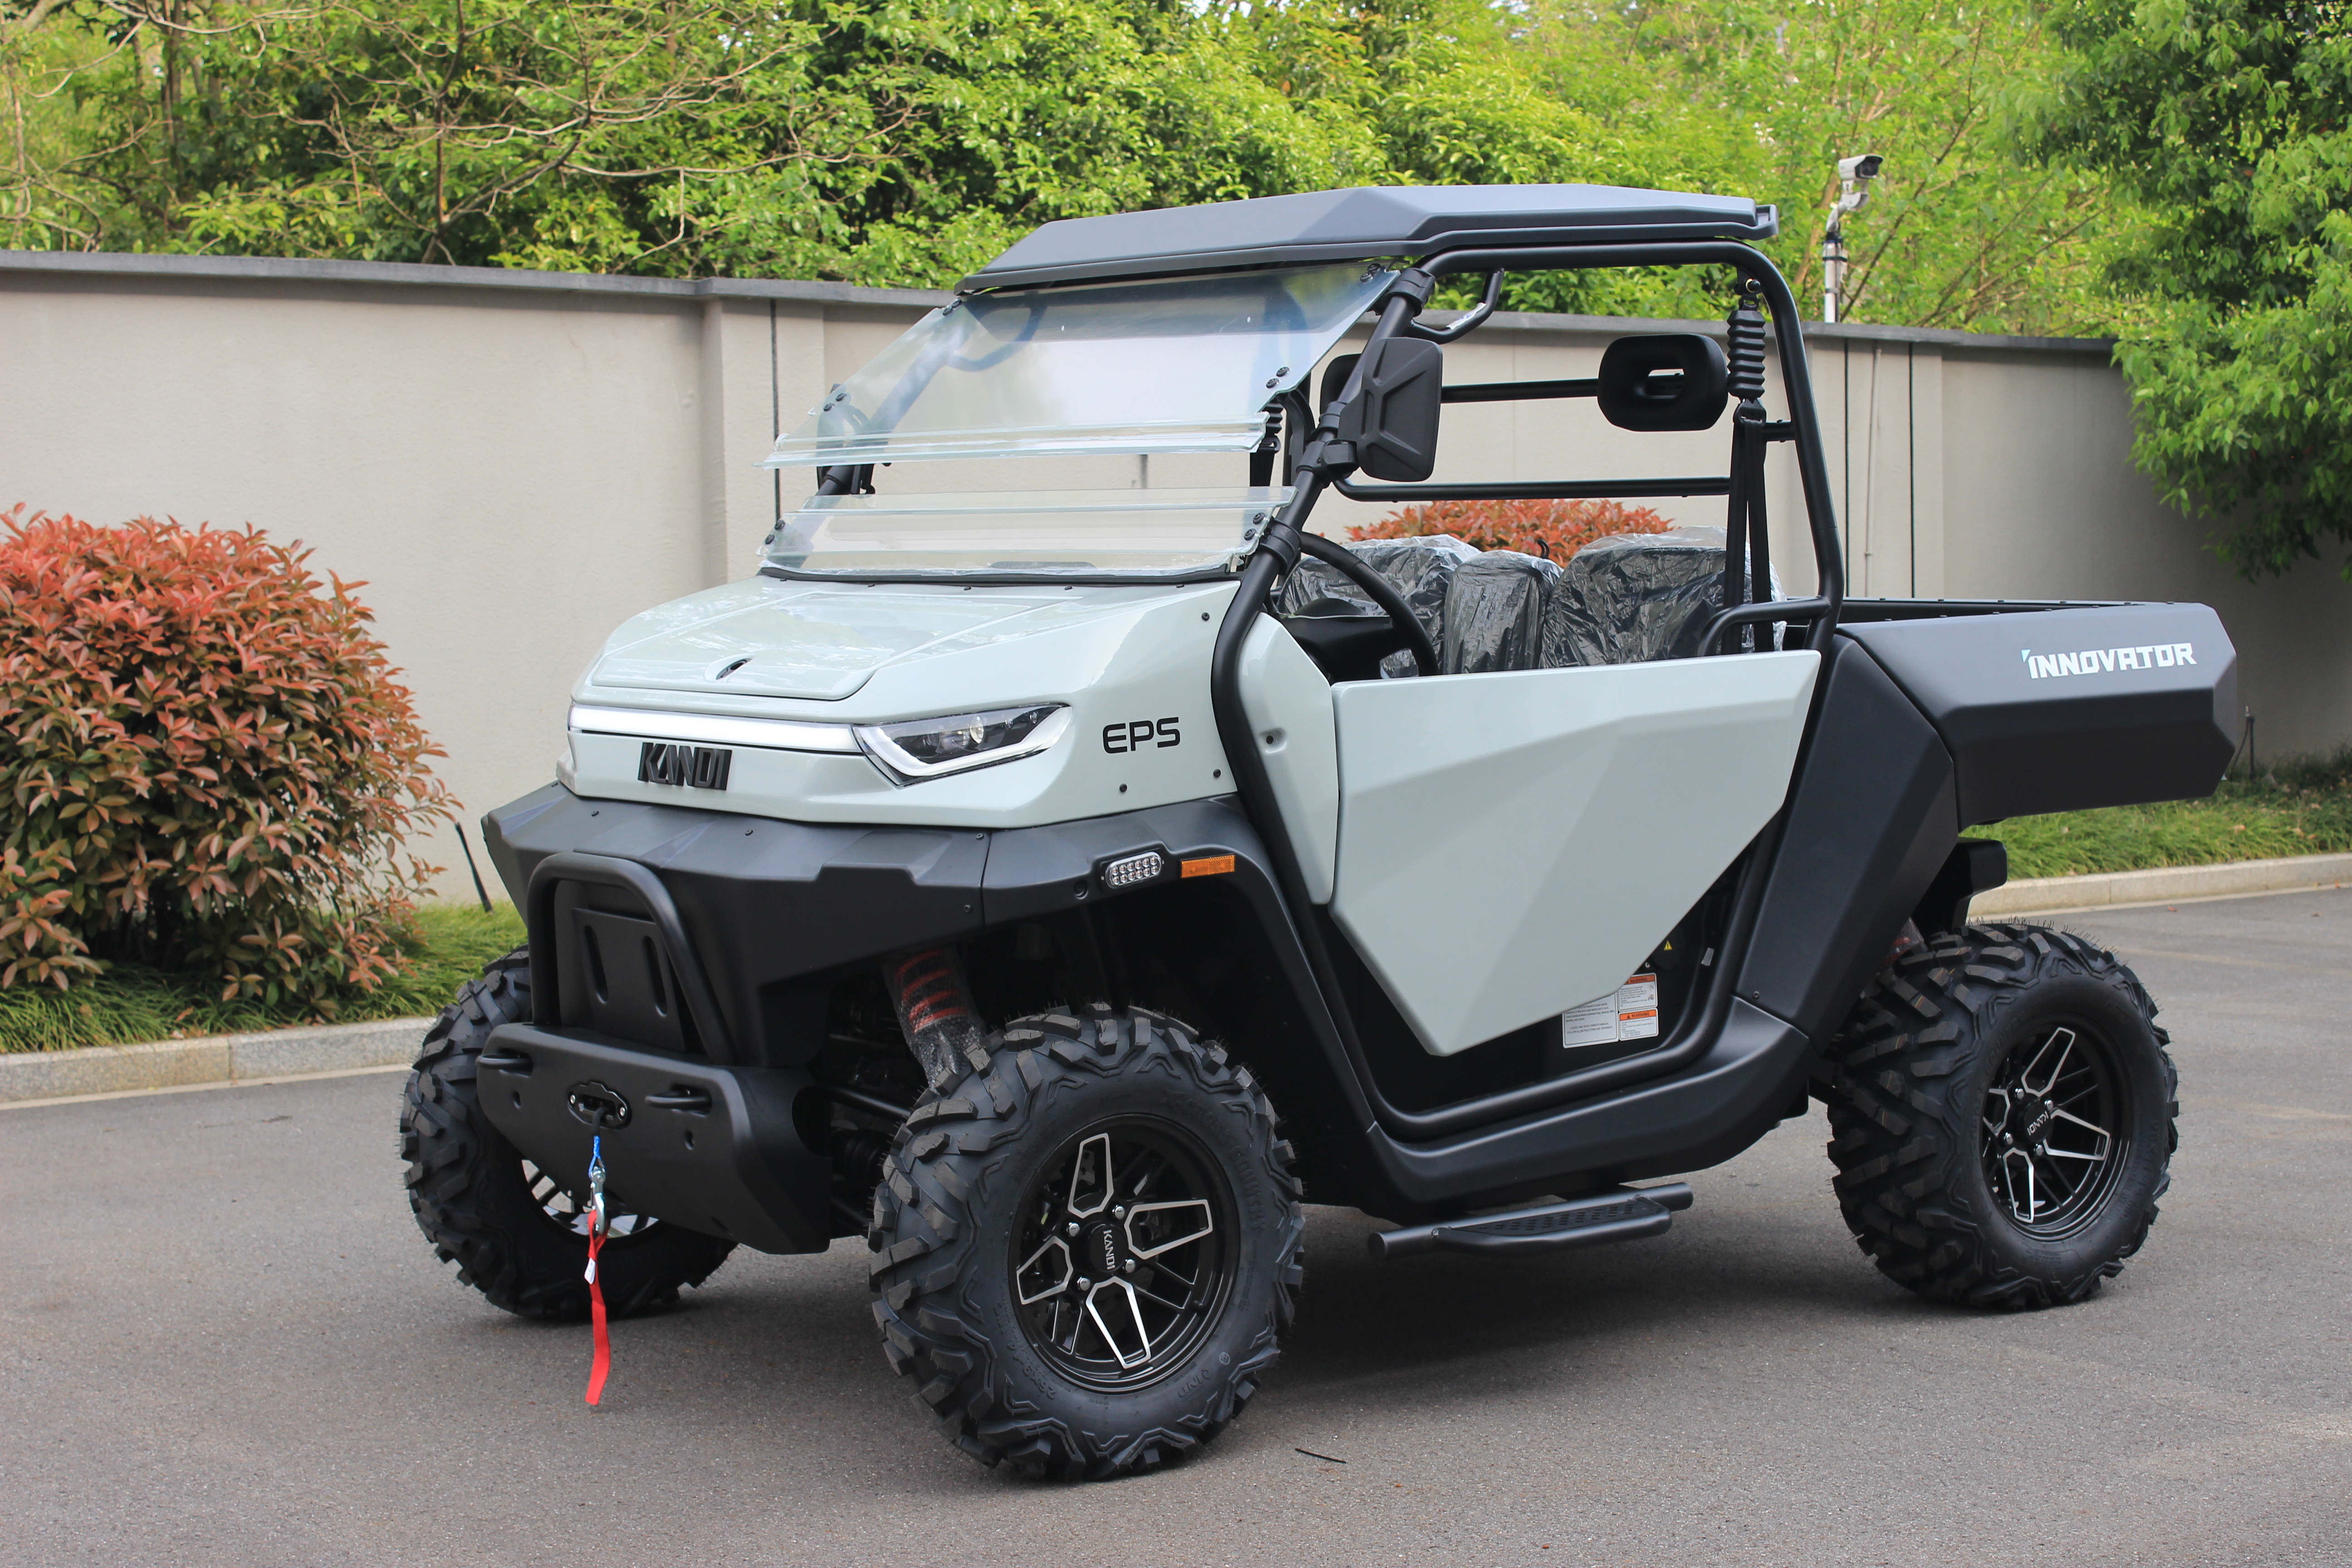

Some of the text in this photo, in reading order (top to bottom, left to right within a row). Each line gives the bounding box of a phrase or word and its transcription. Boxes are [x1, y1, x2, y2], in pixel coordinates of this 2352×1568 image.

[2021, 642, 2197, 679] INNOVATOR
[1102, 716, 1181, 754] EPS
[637, 742, 732, 790] KANDI
[2026, 1111, 2049, 1136] KANDI
[1229, 1146, 1266, 1231] COUNTRY
[1103, 1230, 1116, 1270] KANDI
